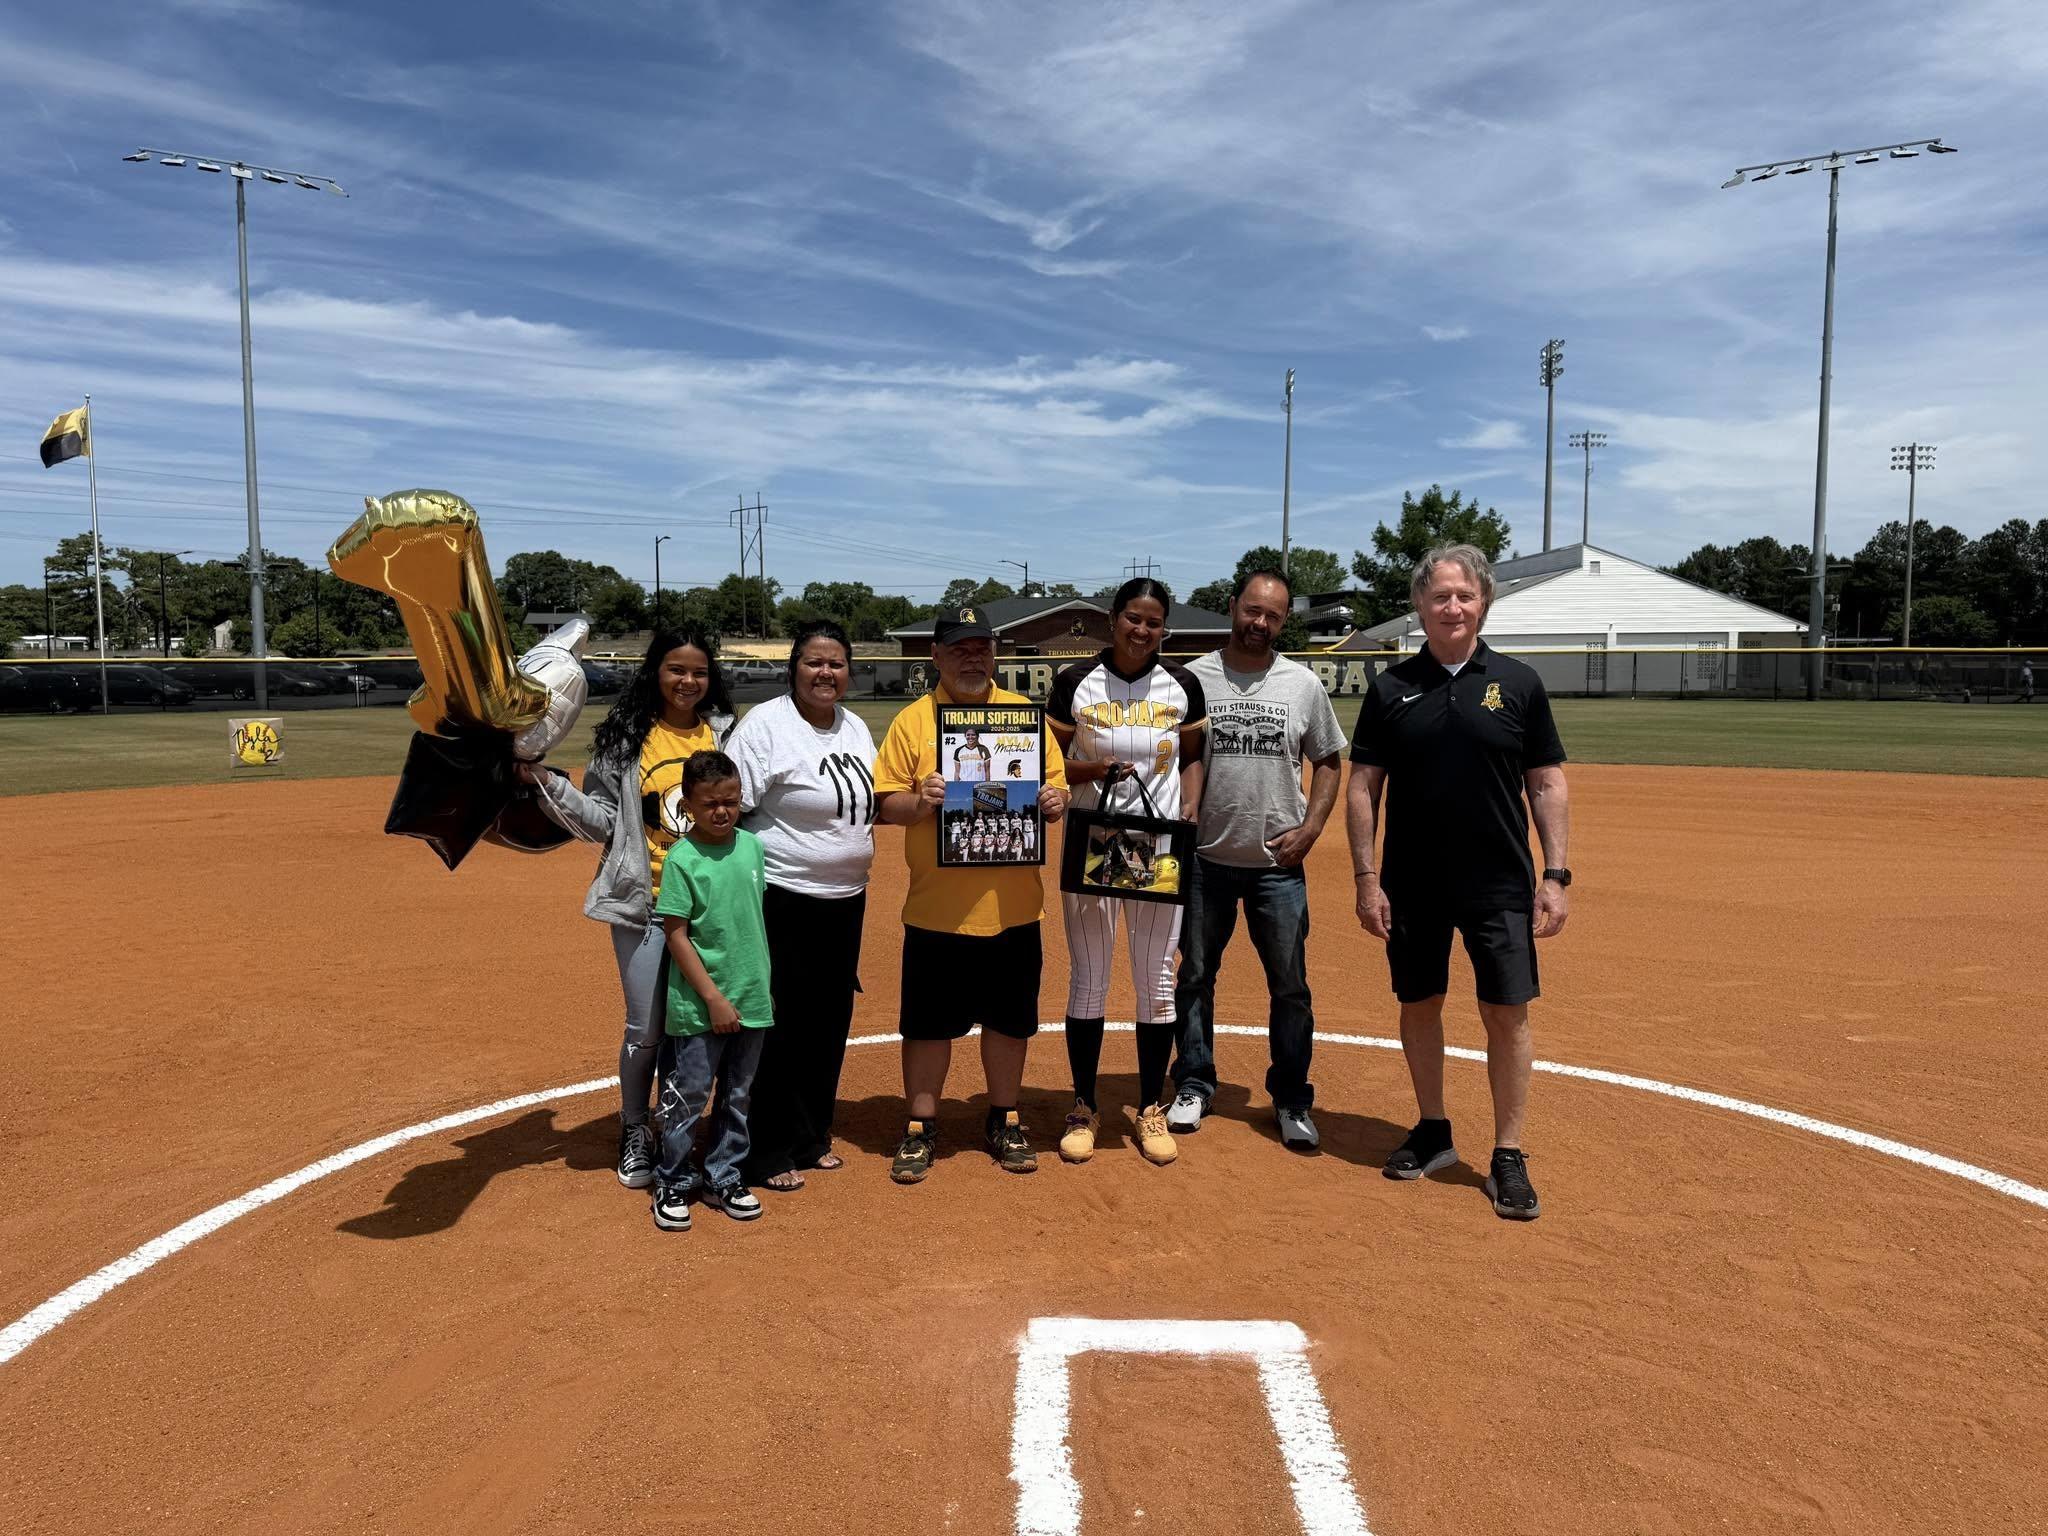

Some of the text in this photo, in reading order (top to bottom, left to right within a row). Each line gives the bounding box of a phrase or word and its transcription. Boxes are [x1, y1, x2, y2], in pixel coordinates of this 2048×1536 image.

[998, 664, 1075, 697] TR
[944, 711, 1037, 725] TROJAN SOFTBALL
[1080, 699, 1178, 731] TROJANS
[1209, 703, 1288, 717] LEVI STRAUSS & CO.
[945, 736, 956, 746] #2
[1153, 740, 1173, 774] 2
[976, 790, 1004, 808] TROJANS
